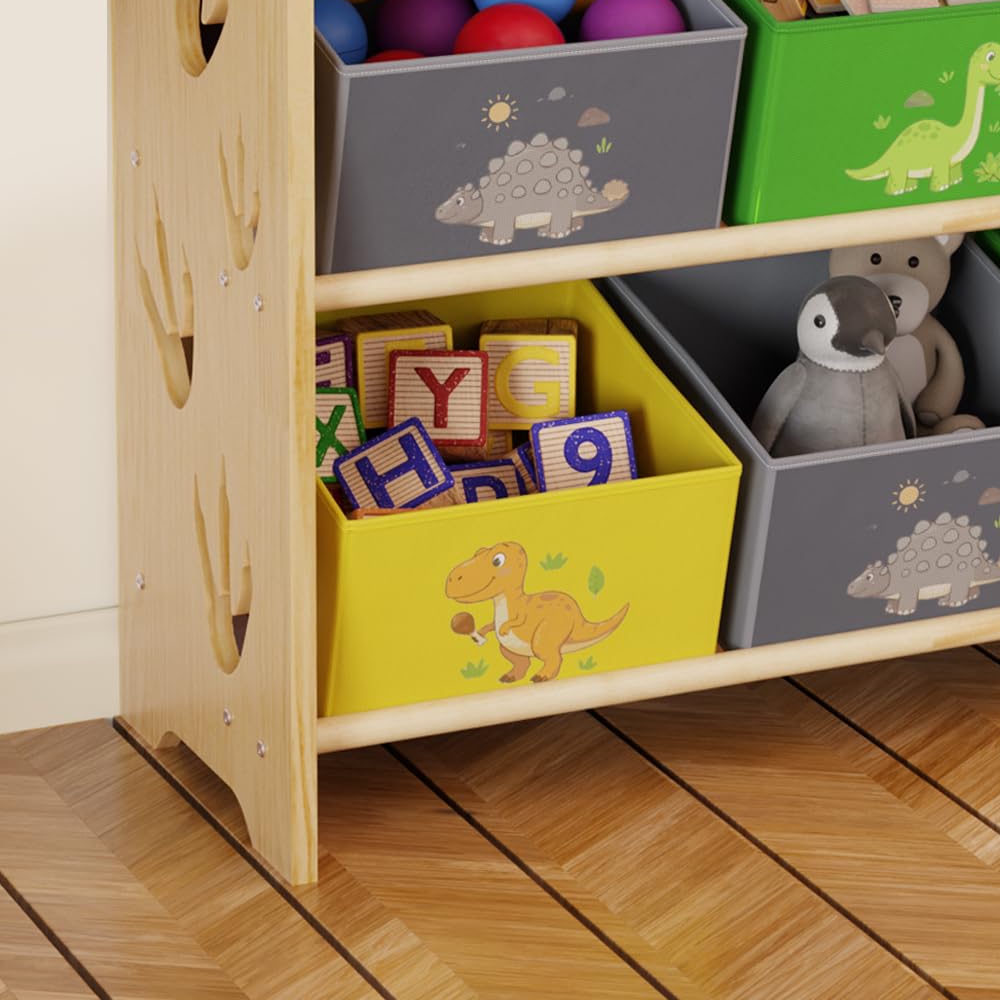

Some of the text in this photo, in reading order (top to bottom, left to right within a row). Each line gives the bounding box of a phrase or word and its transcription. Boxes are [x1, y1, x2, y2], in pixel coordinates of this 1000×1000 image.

[413, 367, 471, 428] Y
[495, 345, 561, 419] G
[354, 432, 440, 509] H
[563, 426, 613, 488] 9
